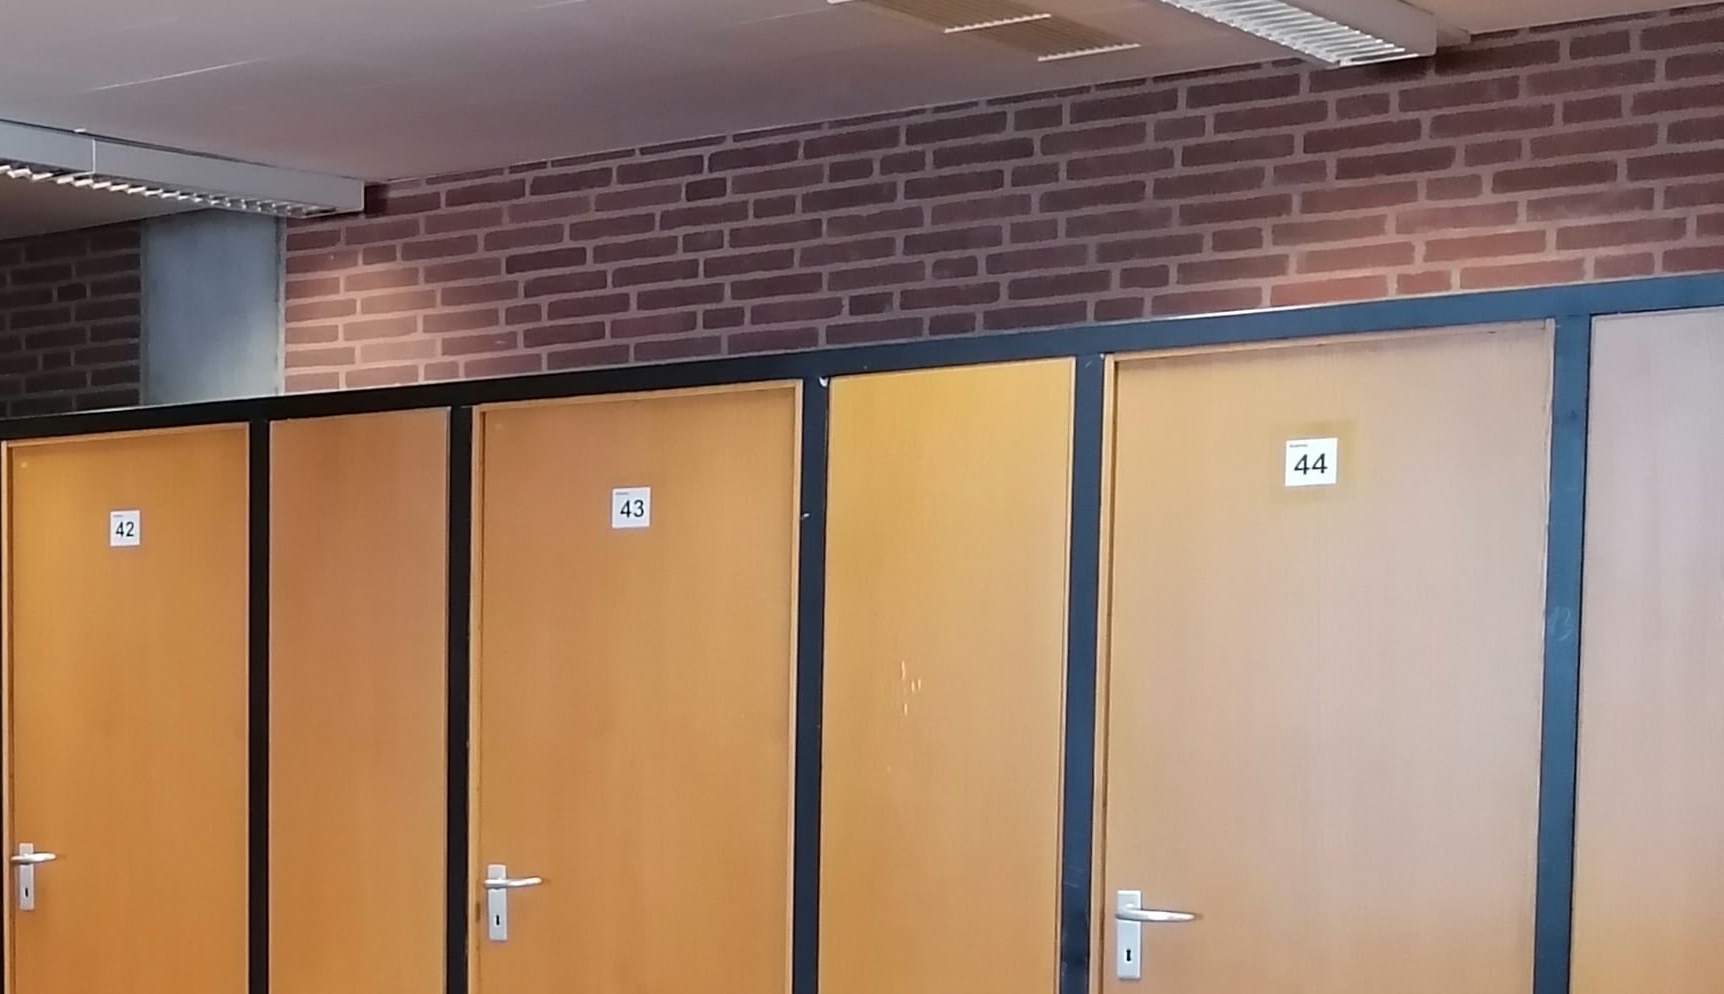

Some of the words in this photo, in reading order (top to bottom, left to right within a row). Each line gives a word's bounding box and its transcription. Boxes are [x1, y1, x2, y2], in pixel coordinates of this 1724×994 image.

[1294, 452, 1328, 475] 44
[620, 499, 644, 518] 43
[115, 520, 134, 538] 42
